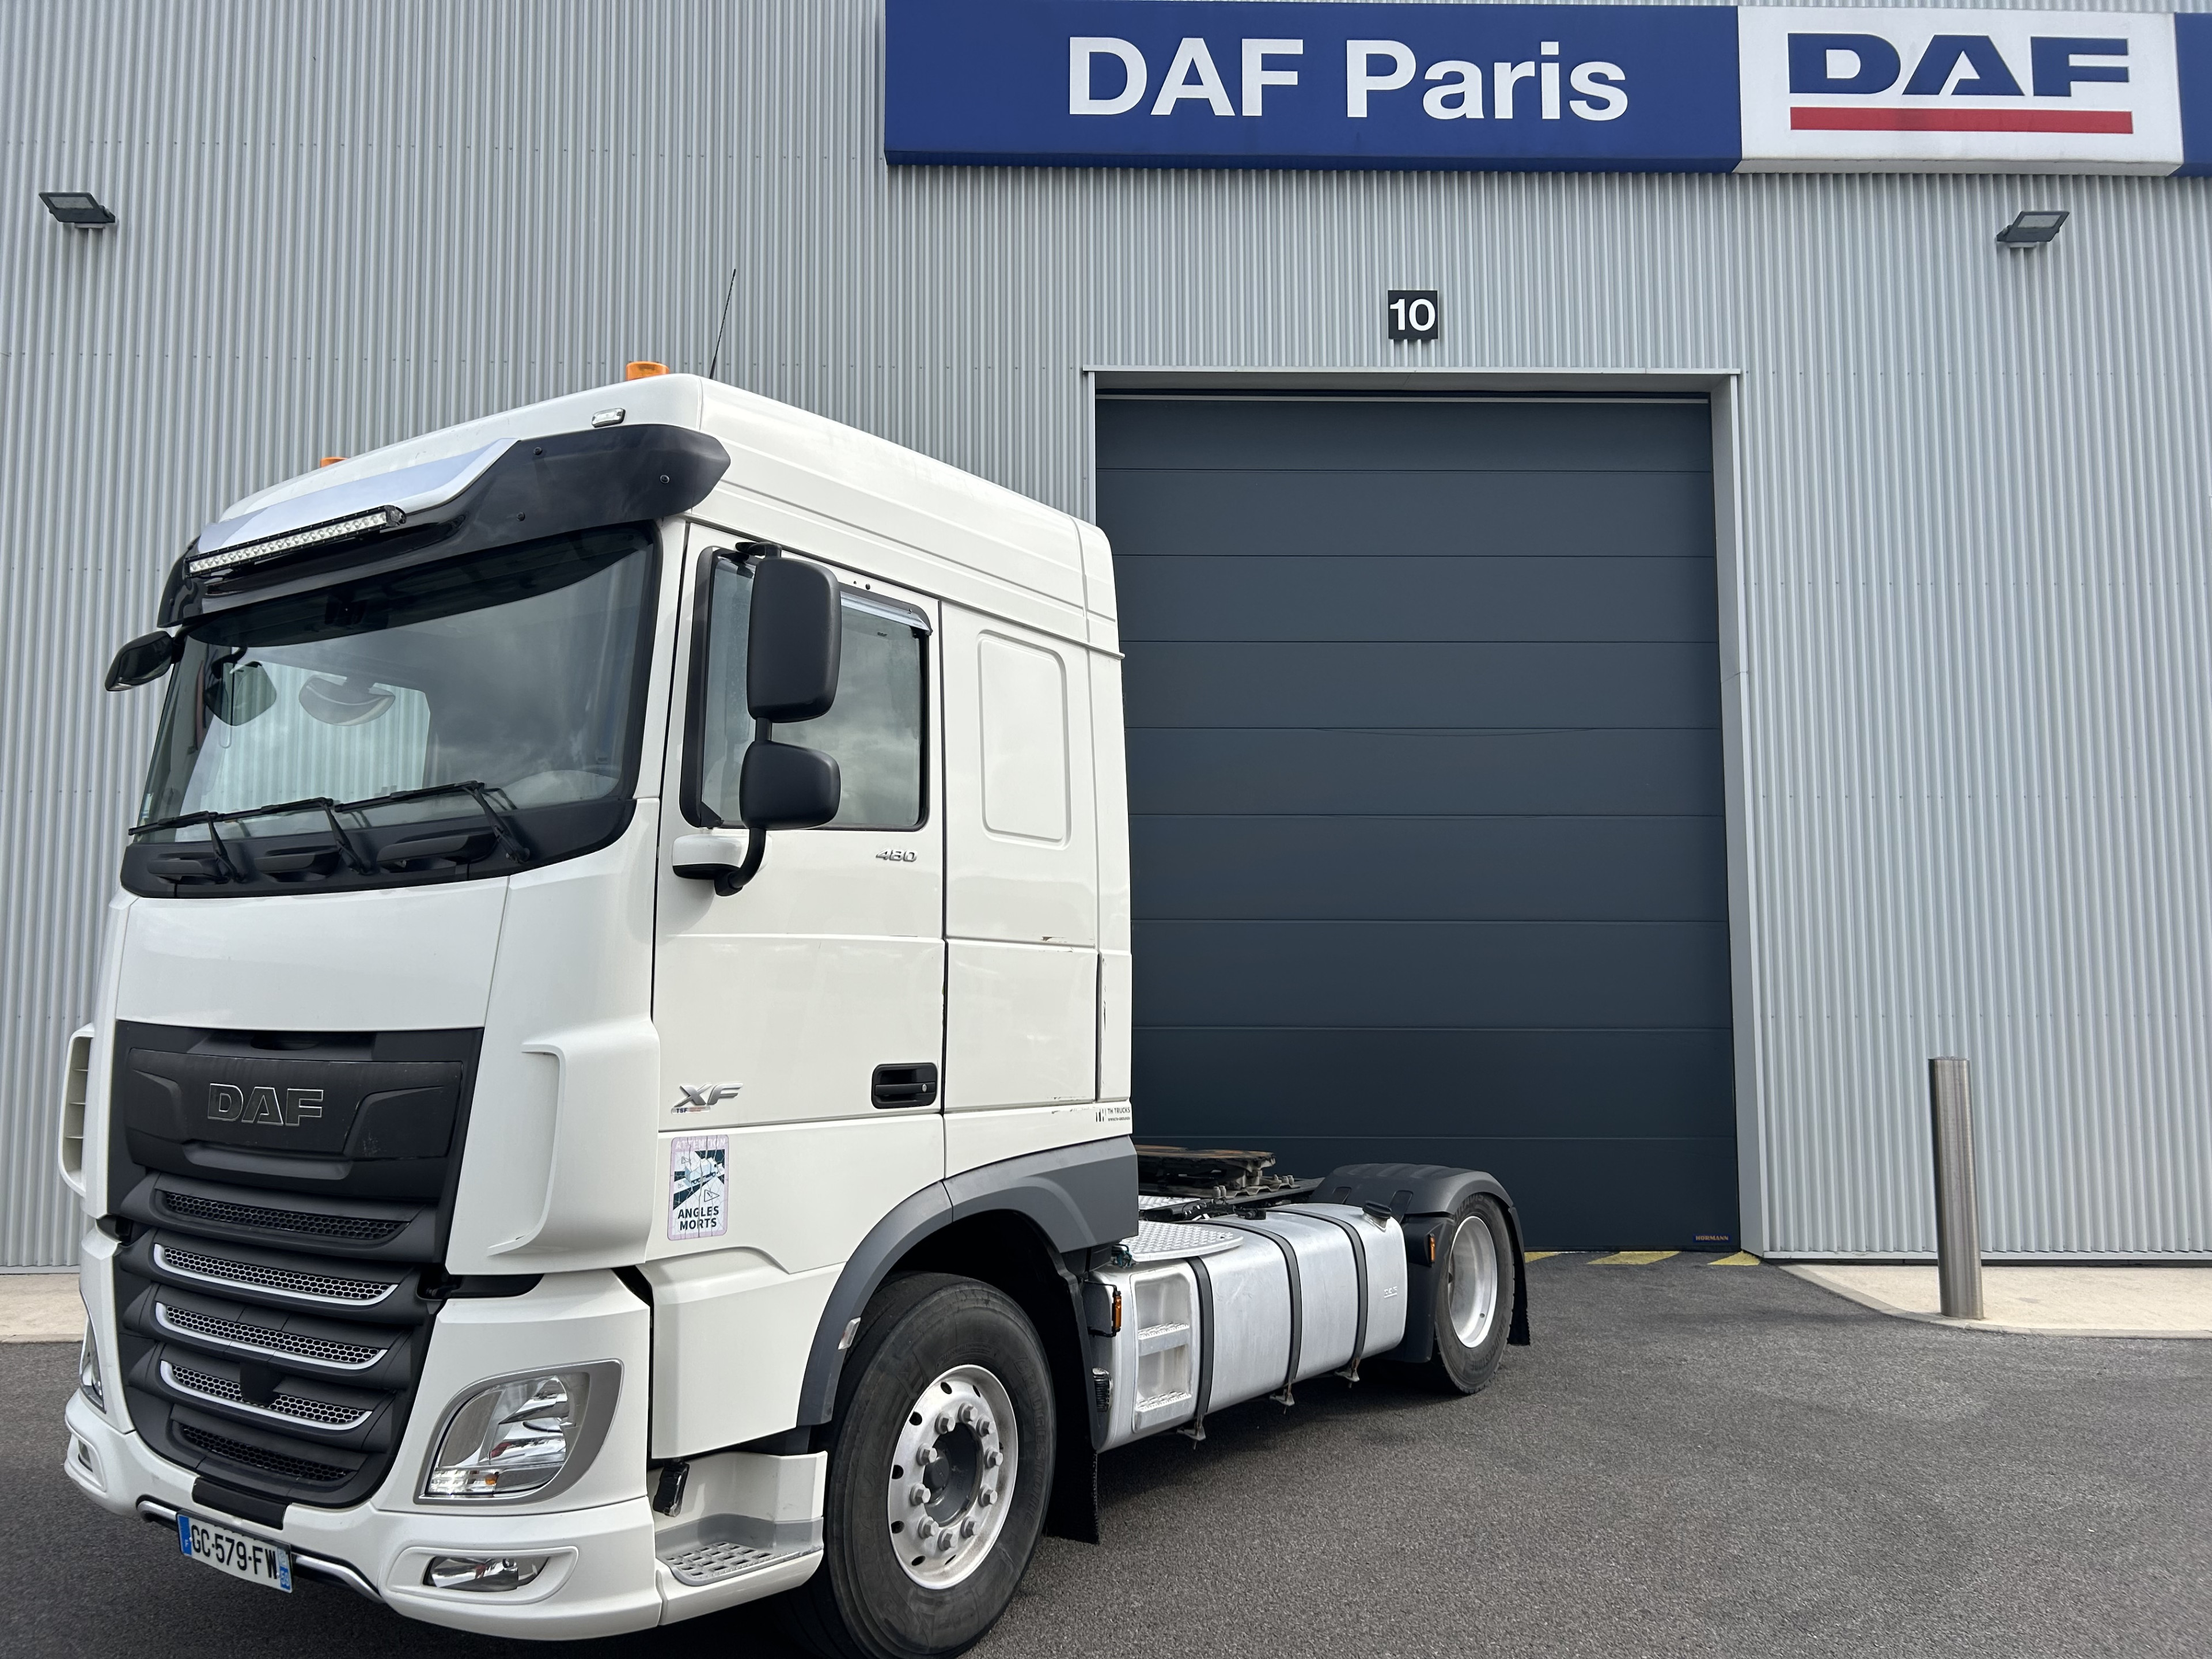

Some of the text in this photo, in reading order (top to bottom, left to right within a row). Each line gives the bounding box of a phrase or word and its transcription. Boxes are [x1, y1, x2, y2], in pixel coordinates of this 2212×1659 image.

[1069, 37, 1628, 120] DAF Paris
[1787, 33, 2130, 97] DAF
[1389, 298, 1435, 331] 10
[876, 848, 918, 862] 480
[207, 1082, 324, 1127] DAF
[674, 1083, 743, 1107] XF
[675, 1138, 726, 1150] ATTENTION
[677, 1206, 719, 1219] ANGLES
[680, 1218, 717, 1230] MORTS
[191, 1525, 278, 1580] GC-579-FW
